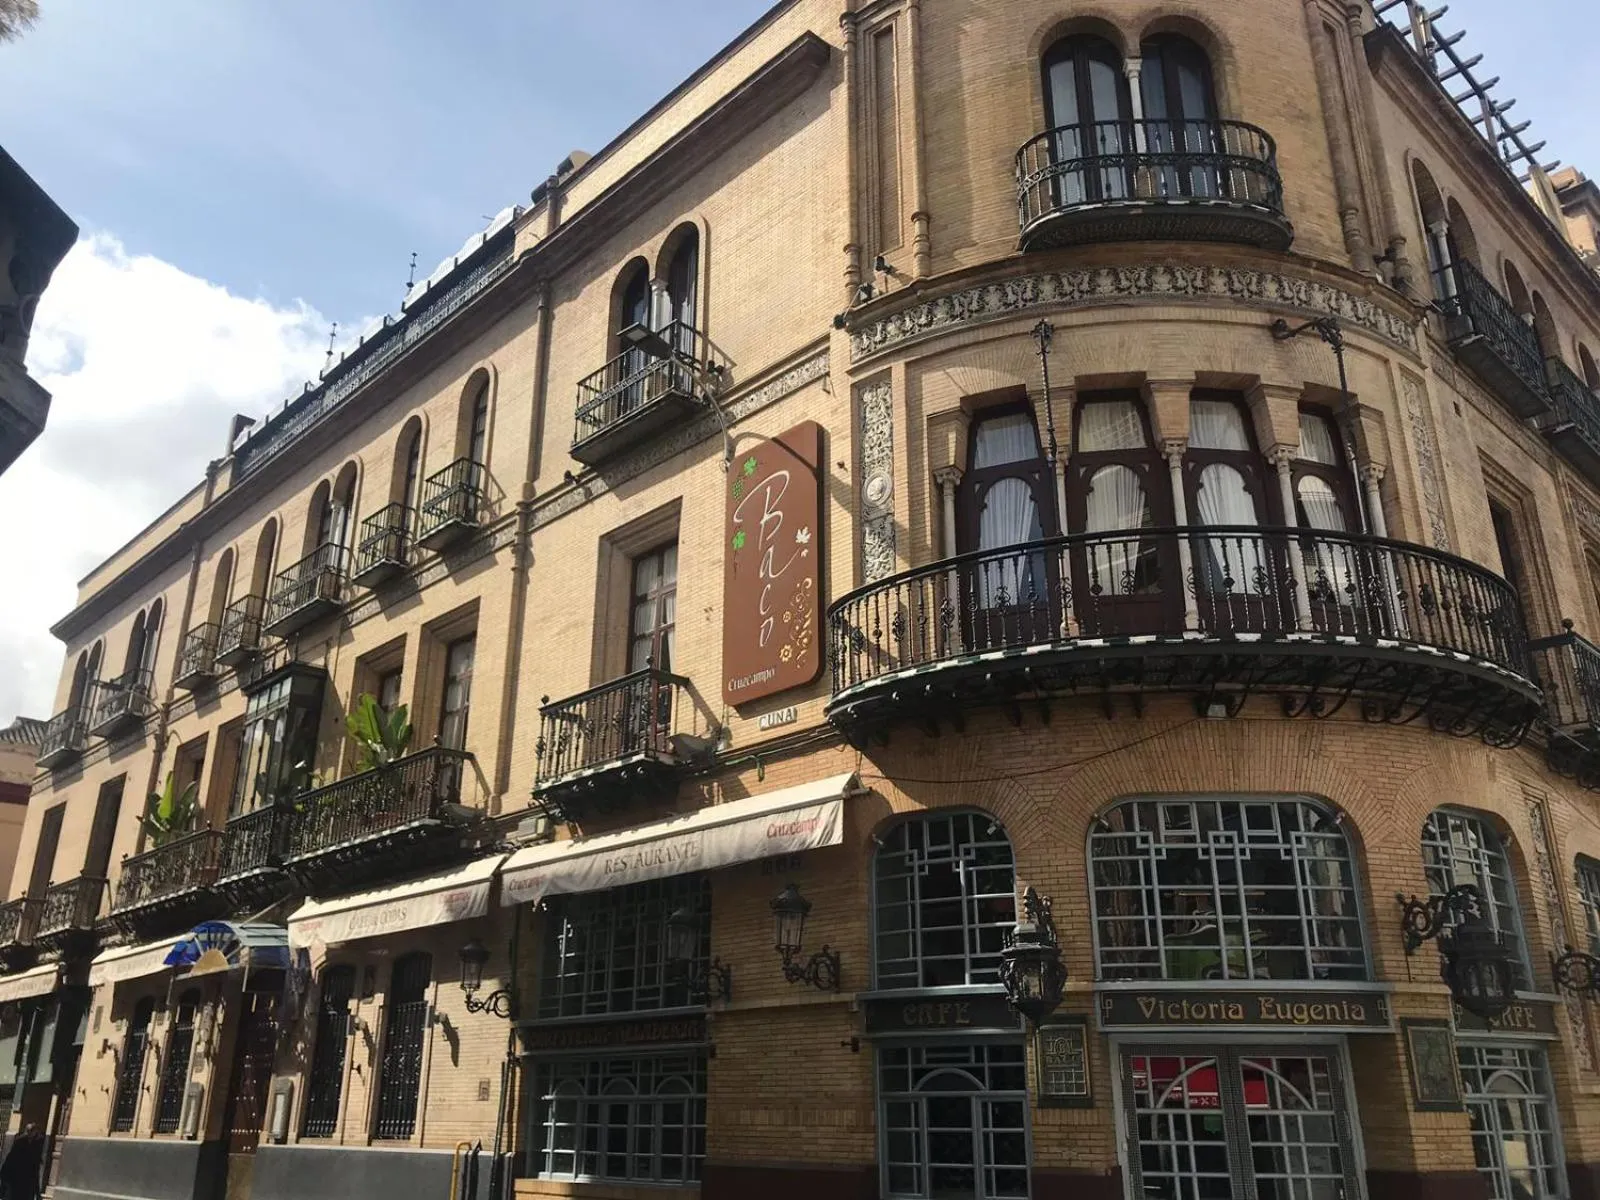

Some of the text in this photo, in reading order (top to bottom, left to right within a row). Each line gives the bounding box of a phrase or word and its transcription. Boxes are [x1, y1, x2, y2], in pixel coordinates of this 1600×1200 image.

[604, 841, 701, 875] RESTAURANTE
[903, 1002, 971, 1025] CAFE
[1136, 996, 1366, 1024] Victoria Eugenia
